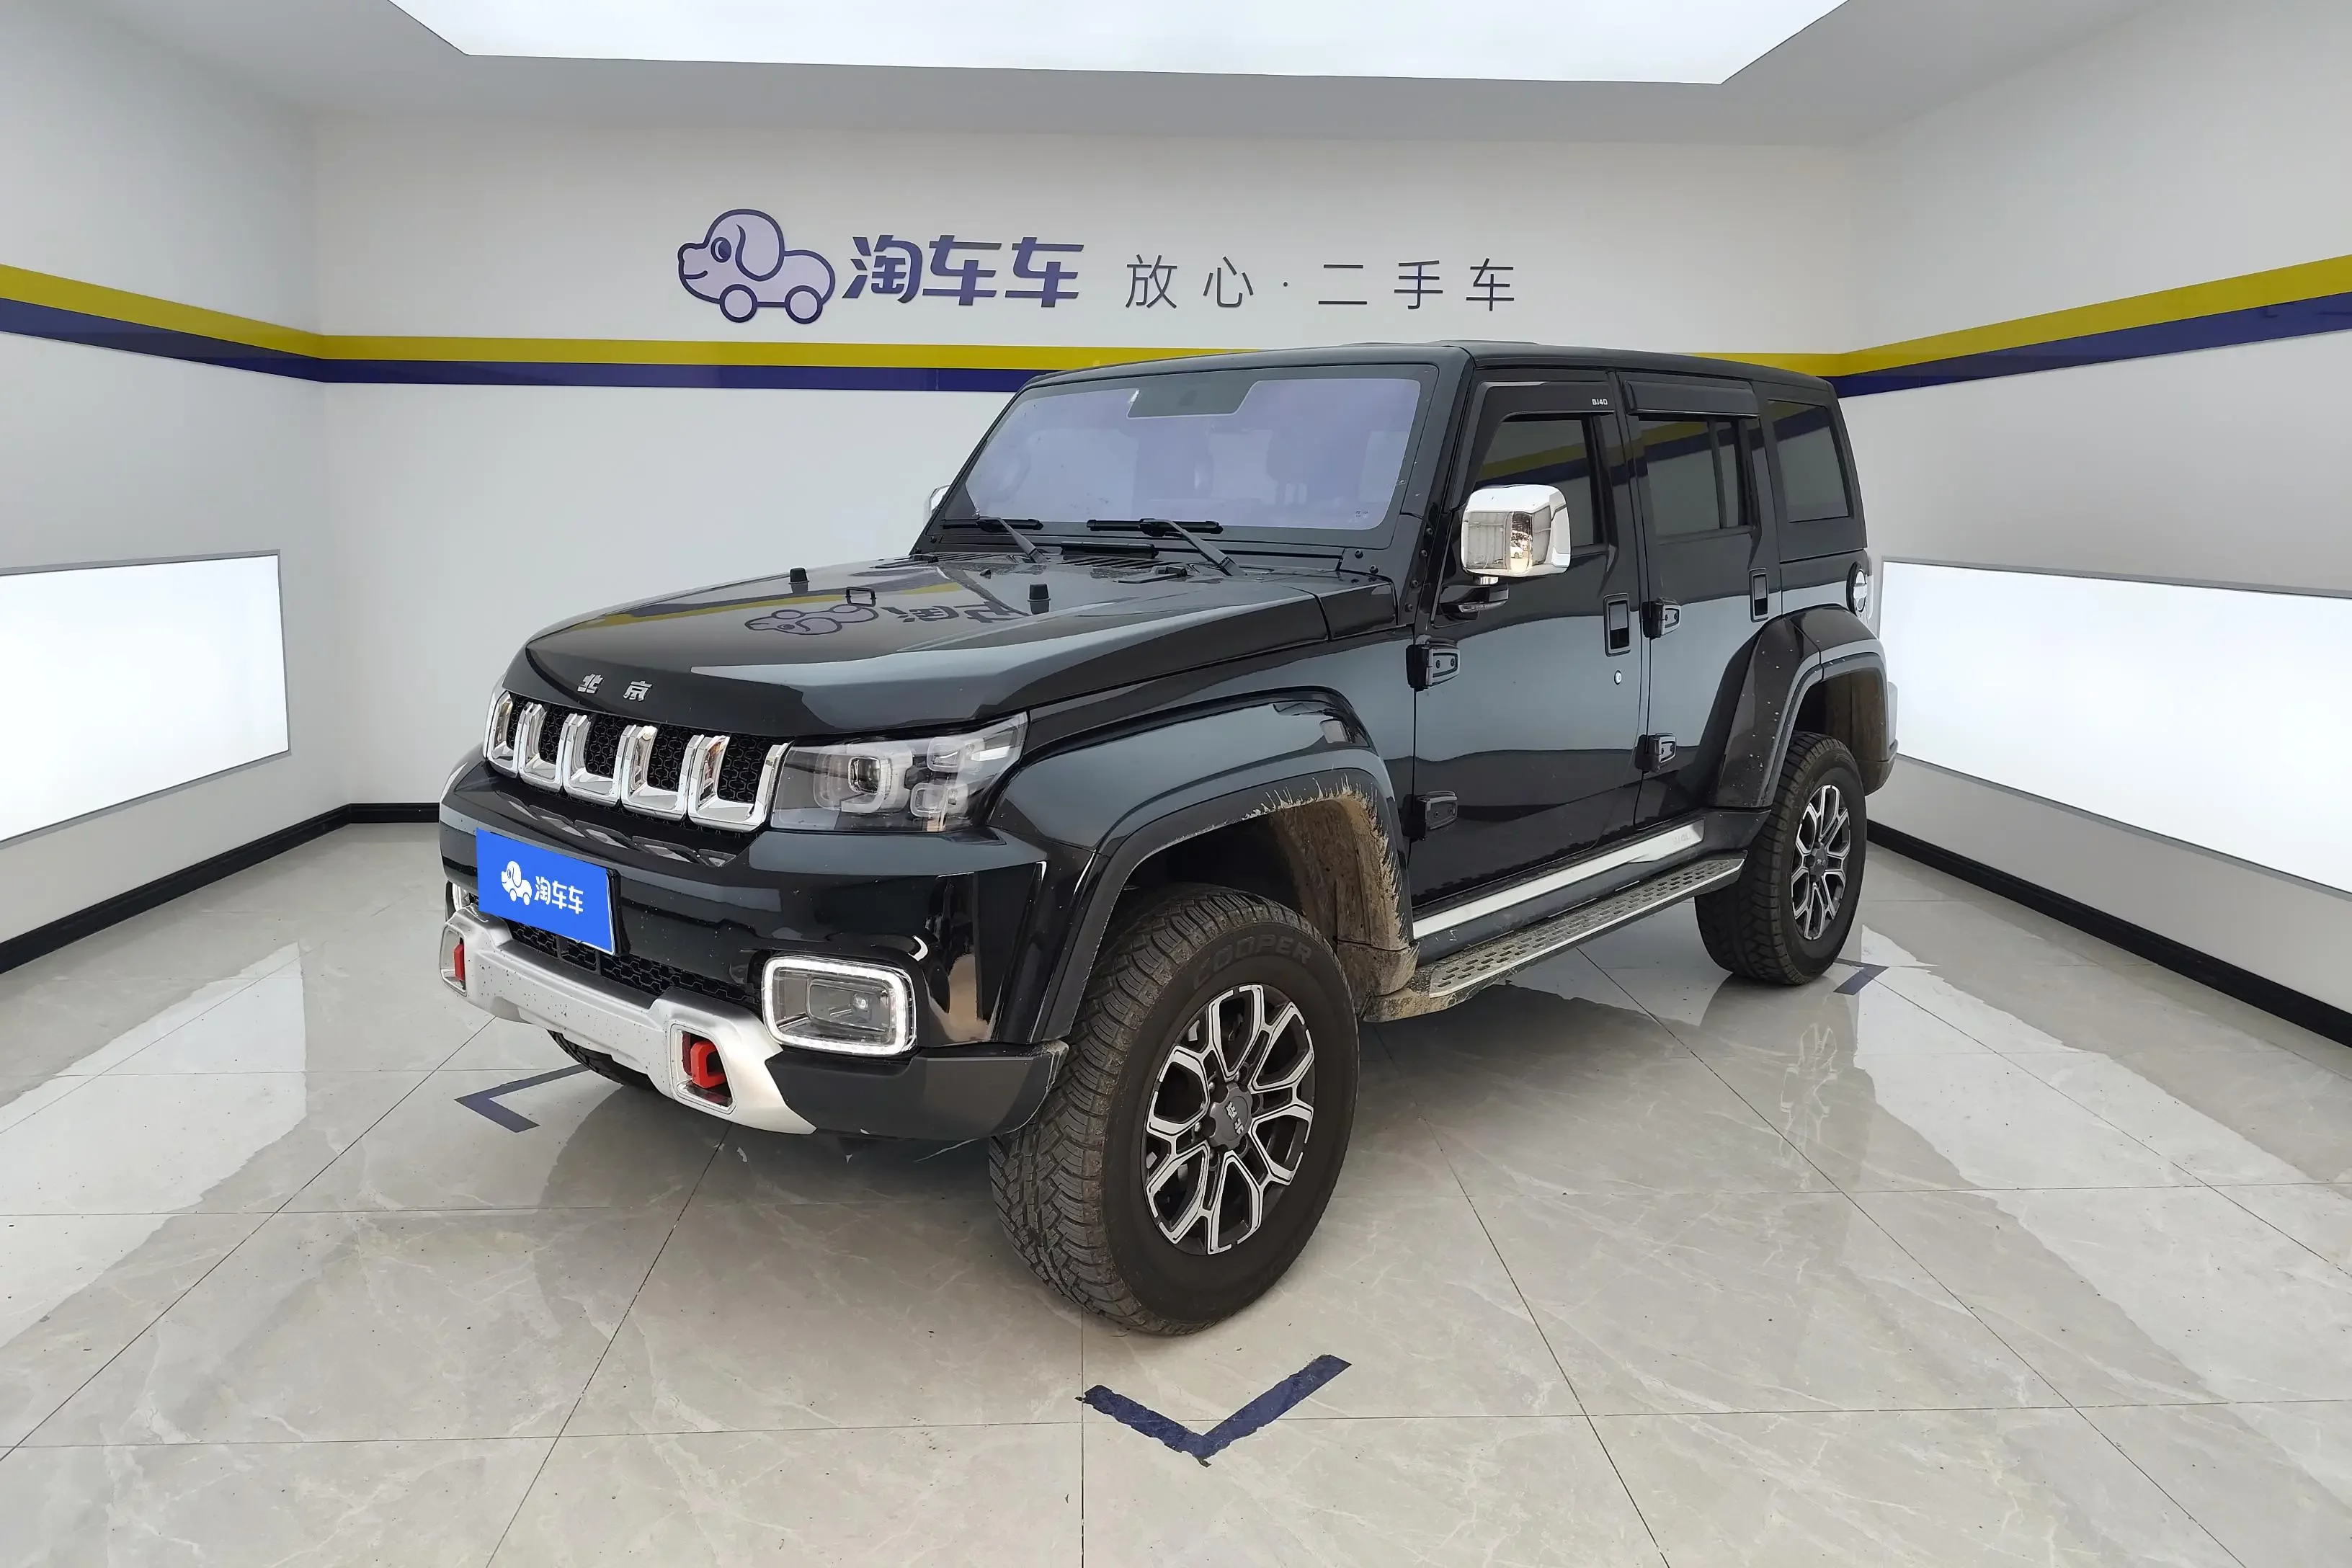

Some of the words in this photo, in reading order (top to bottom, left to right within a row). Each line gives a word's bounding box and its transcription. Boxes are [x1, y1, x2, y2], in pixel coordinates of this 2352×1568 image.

[841, 234, 1084, 308] 淘车车
[577, 674, 652, 701] 北京
